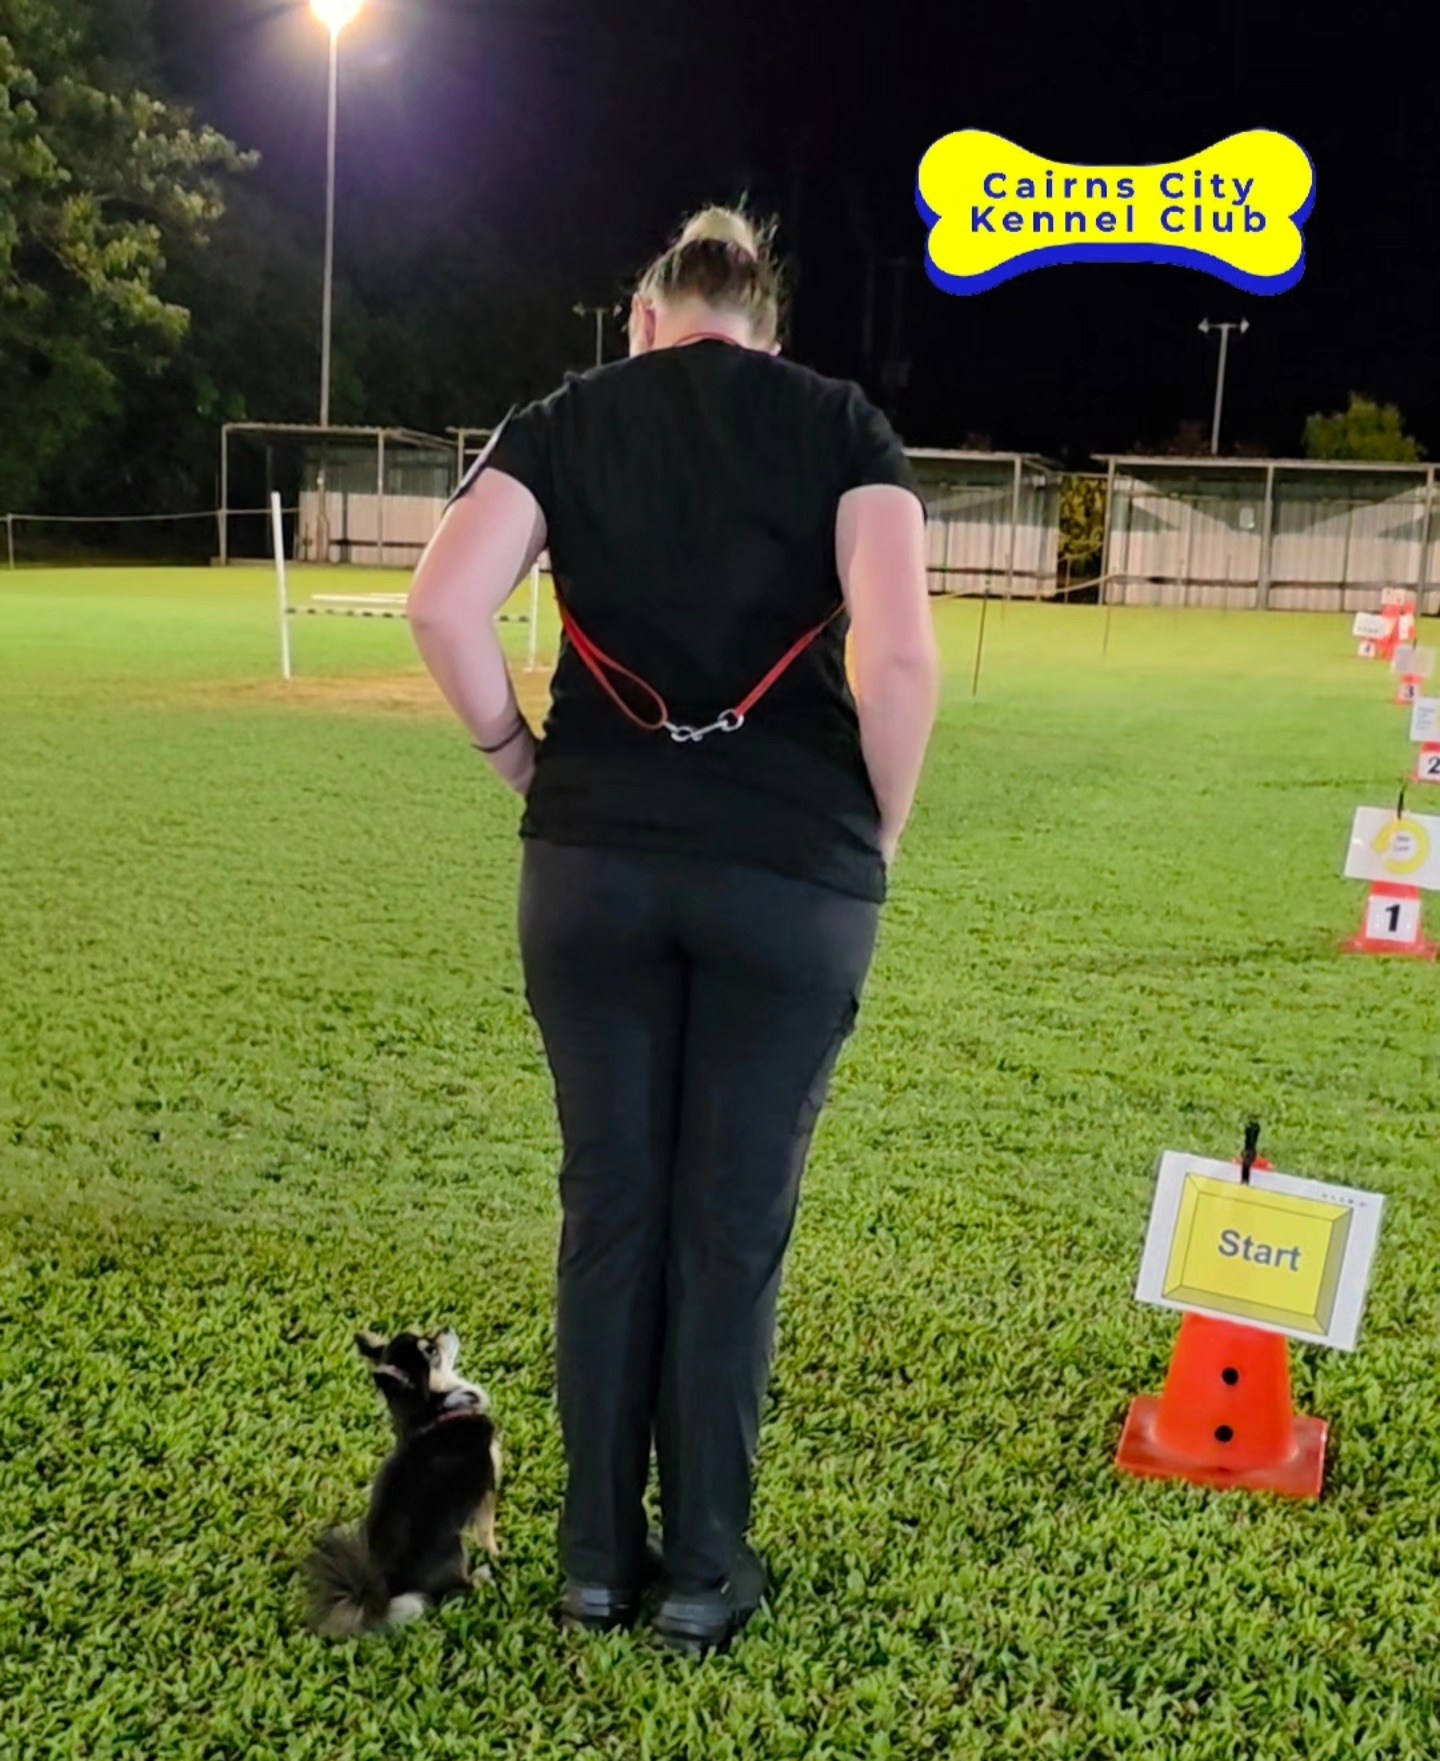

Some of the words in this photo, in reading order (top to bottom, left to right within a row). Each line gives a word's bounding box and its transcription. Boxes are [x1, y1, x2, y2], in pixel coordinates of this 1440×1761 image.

[1427, 756, 1440, 774] 2
[1385, 903, 1401, 933] 1
[1218, 1230, 1301, 1272] Start
